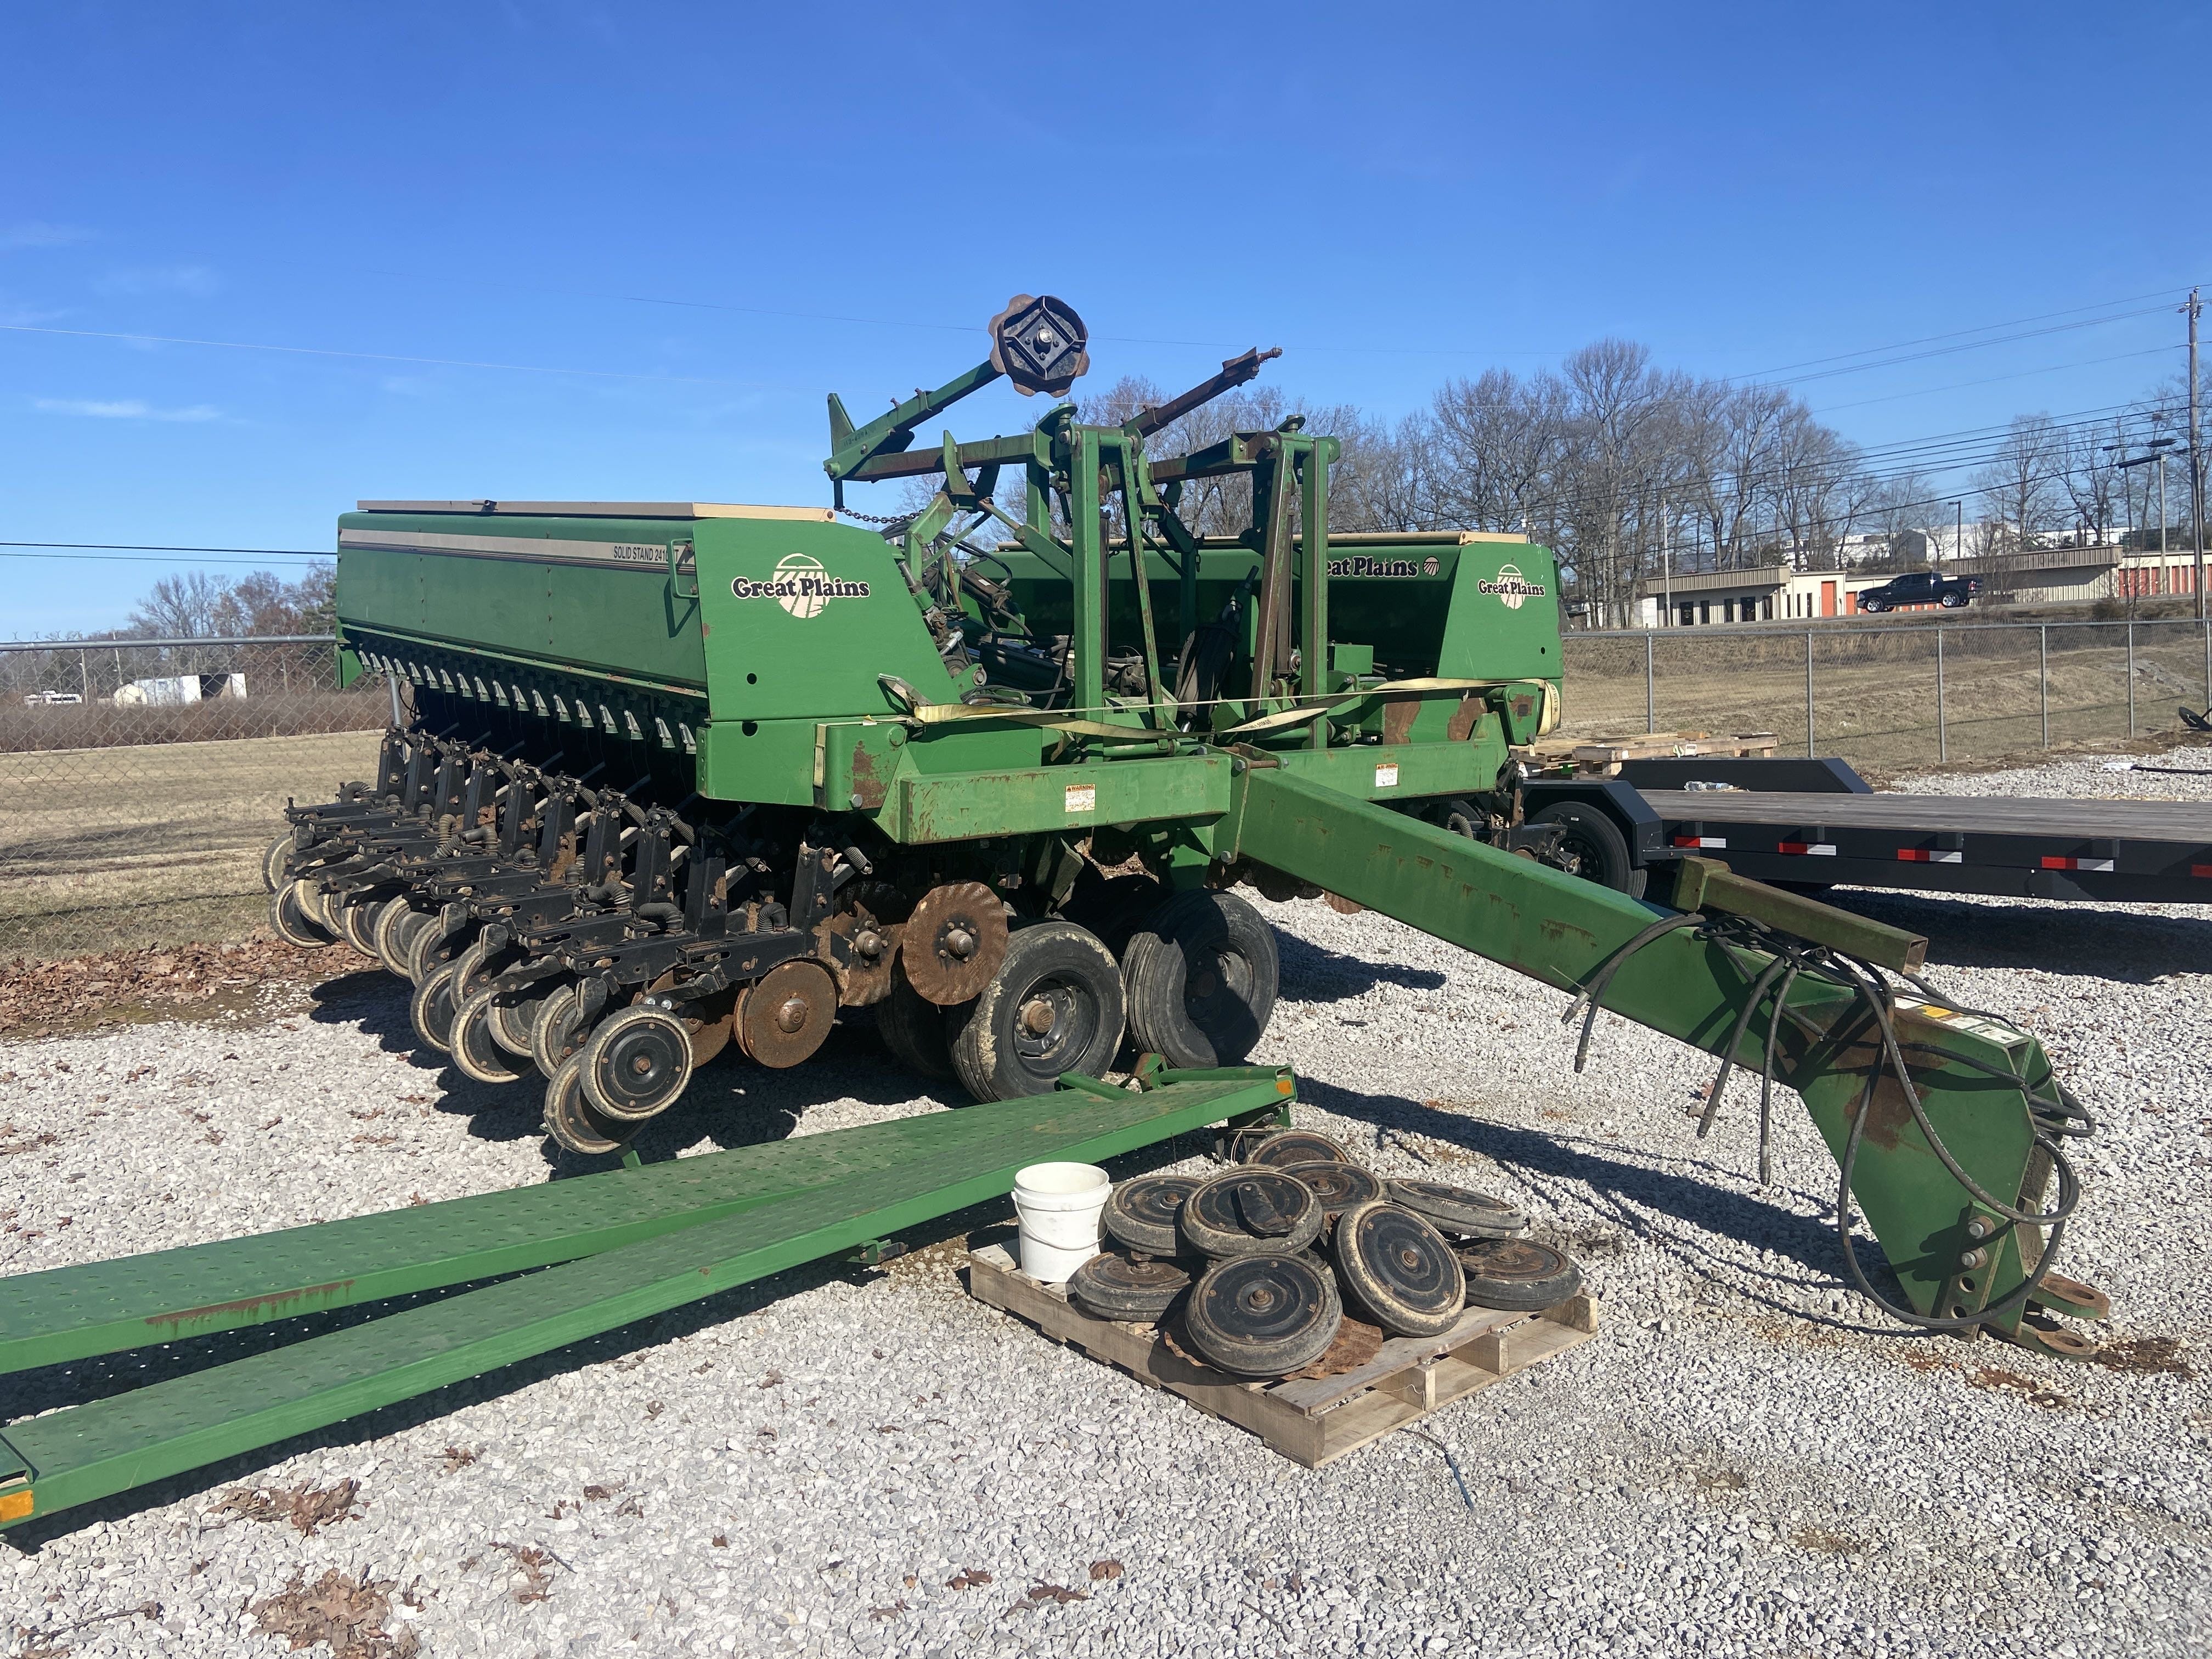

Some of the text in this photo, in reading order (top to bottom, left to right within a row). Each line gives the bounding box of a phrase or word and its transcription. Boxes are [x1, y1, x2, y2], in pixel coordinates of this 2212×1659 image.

[614, 546, 631, 558] SOLID
[633, 547, 653, 561] STAND
[1353, 556, 1418, 577] Plains
[732, 577, 870, 599] Great Plains
[1478, 579, 1545, 596] Great Plains
